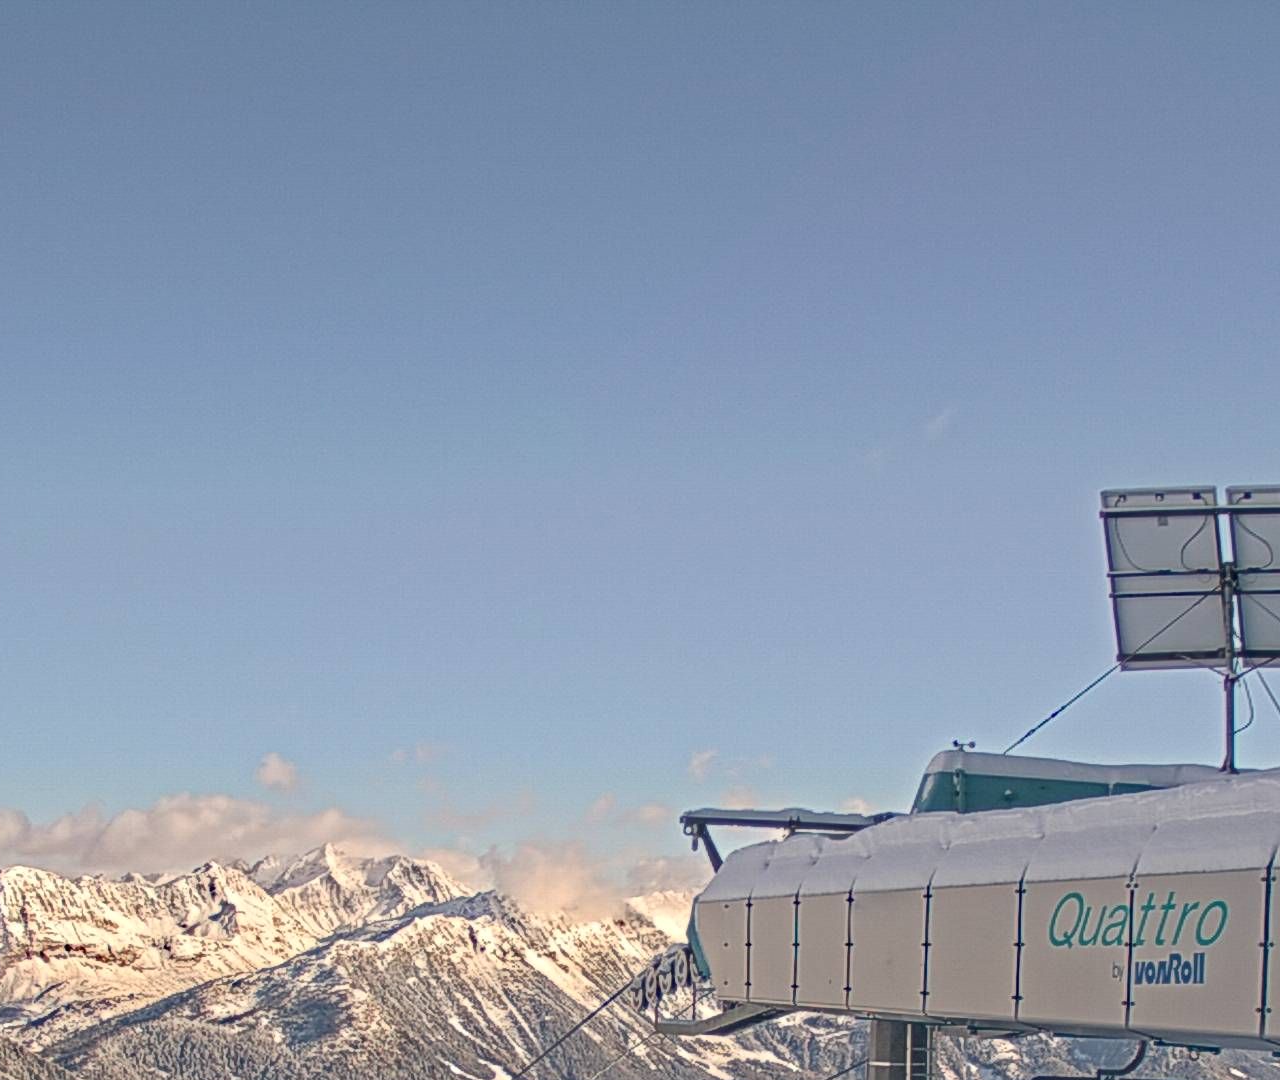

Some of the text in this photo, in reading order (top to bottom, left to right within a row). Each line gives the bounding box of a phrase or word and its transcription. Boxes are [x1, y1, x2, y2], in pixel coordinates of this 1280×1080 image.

[1048, 891, 1228, 949] Quattro
[1112, 952, 1205, 985] by vonRoll
